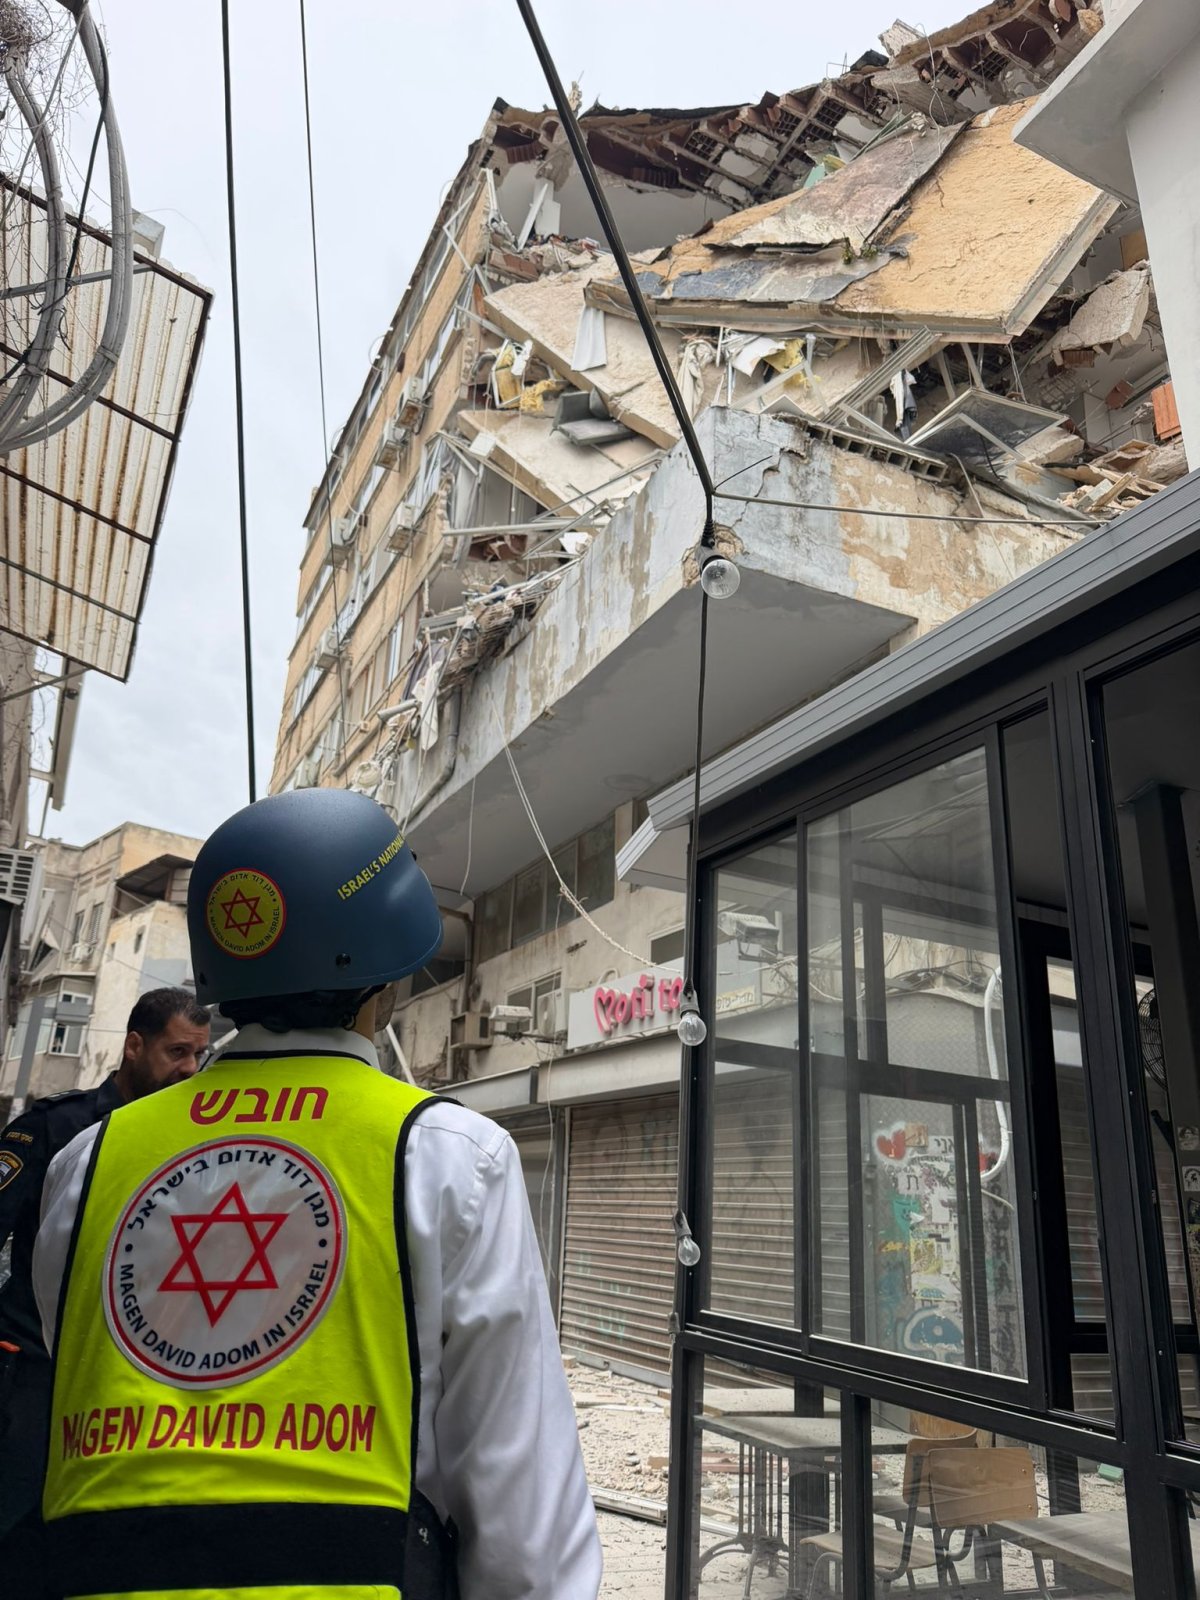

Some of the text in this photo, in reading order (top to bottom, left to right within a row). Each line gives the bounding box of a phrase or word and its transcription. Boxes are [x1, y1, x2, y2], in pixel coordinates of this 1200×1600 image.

[230, 873, 249, 881] אדום
[337, 860, 381, 900] ISRAEL'S
[190, 1086, 329, 1126] חובש
[127, 1149, 330, 1230] מגן דוד אדום בישראל
[120, 1259, 329, 1370] MAGEN DAVID ADOM IN ISRAEL
[147, 1403, 265, 1449] DAVID
[274, 1402, 376, 1452] ADOM
